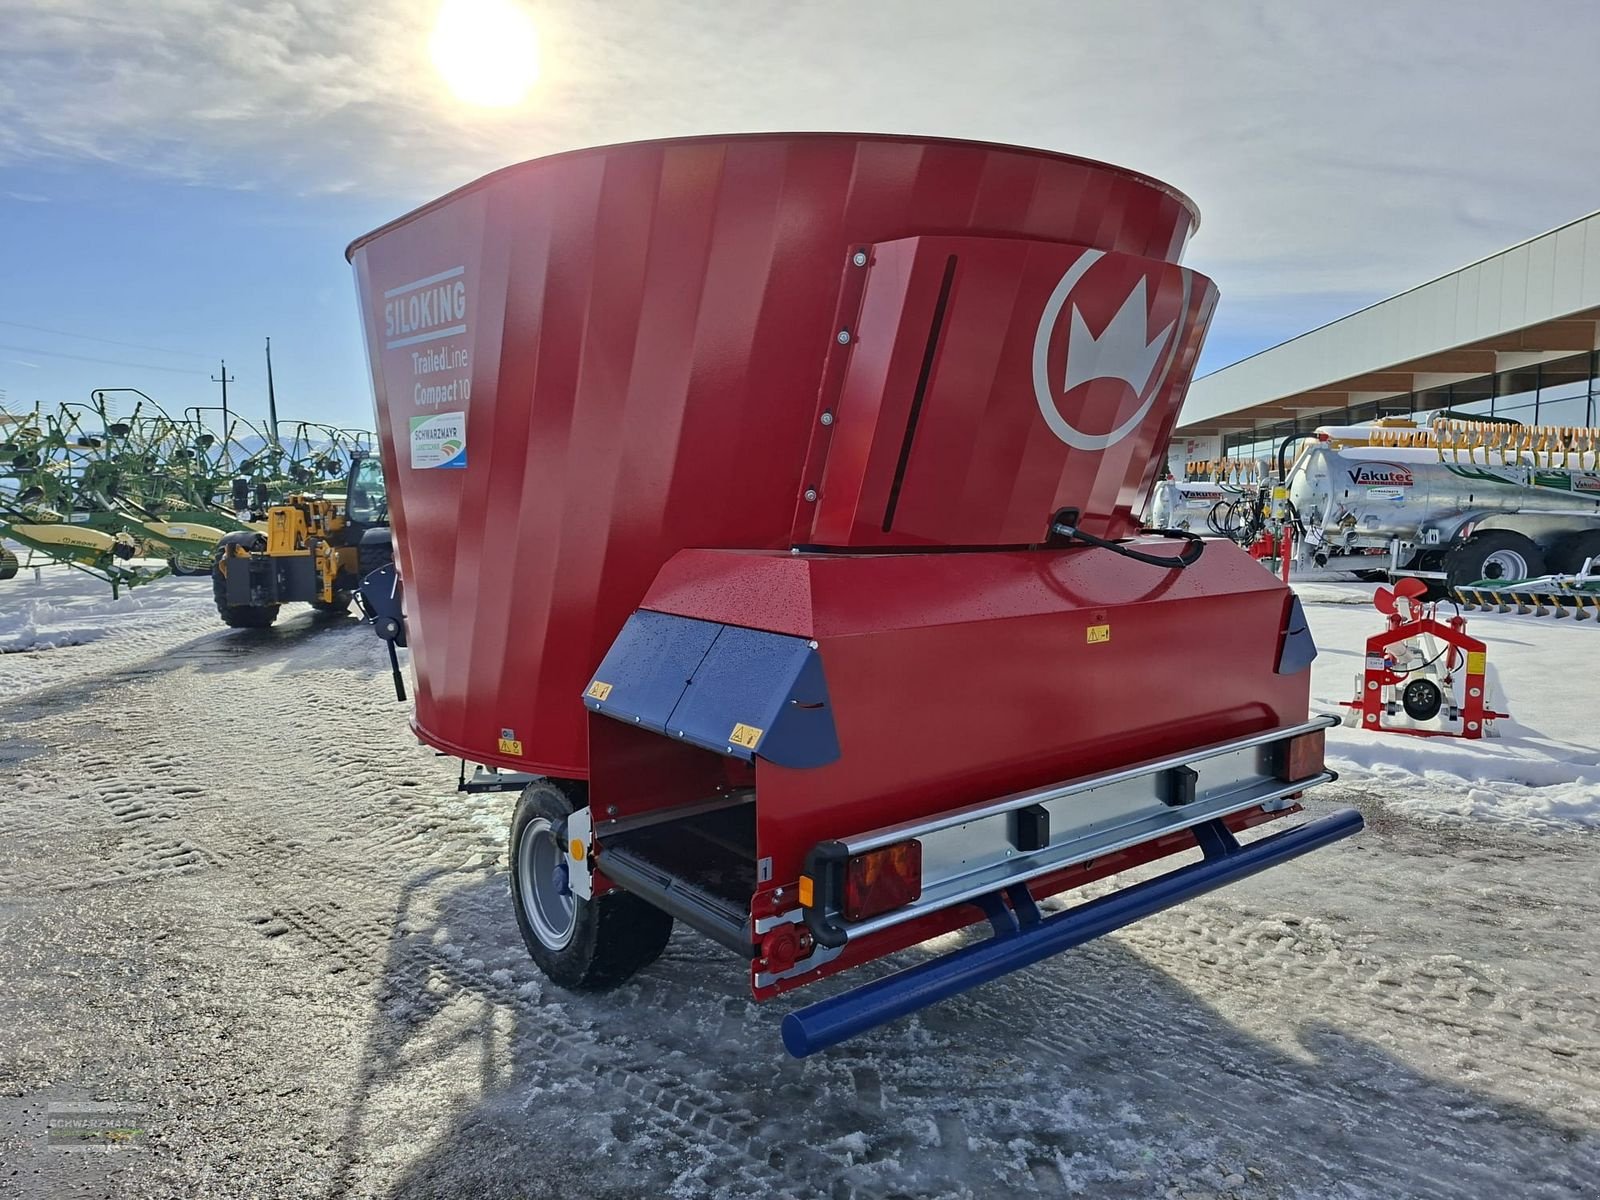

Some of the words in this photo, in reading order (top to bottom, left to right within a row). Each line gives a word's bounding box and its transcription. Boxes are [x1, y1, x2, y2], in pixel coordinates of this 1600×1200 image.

[385, 281, 466, 337] SILOKING
[411, 345, 468, 375] TrailedLine
[414, 379, 457, 410] Compact
[458, 378, 471, 400] 10
[415, 427, 457, 441] SCHWARZMAYR
[1347, 467, 1414, 485] Vakutec
